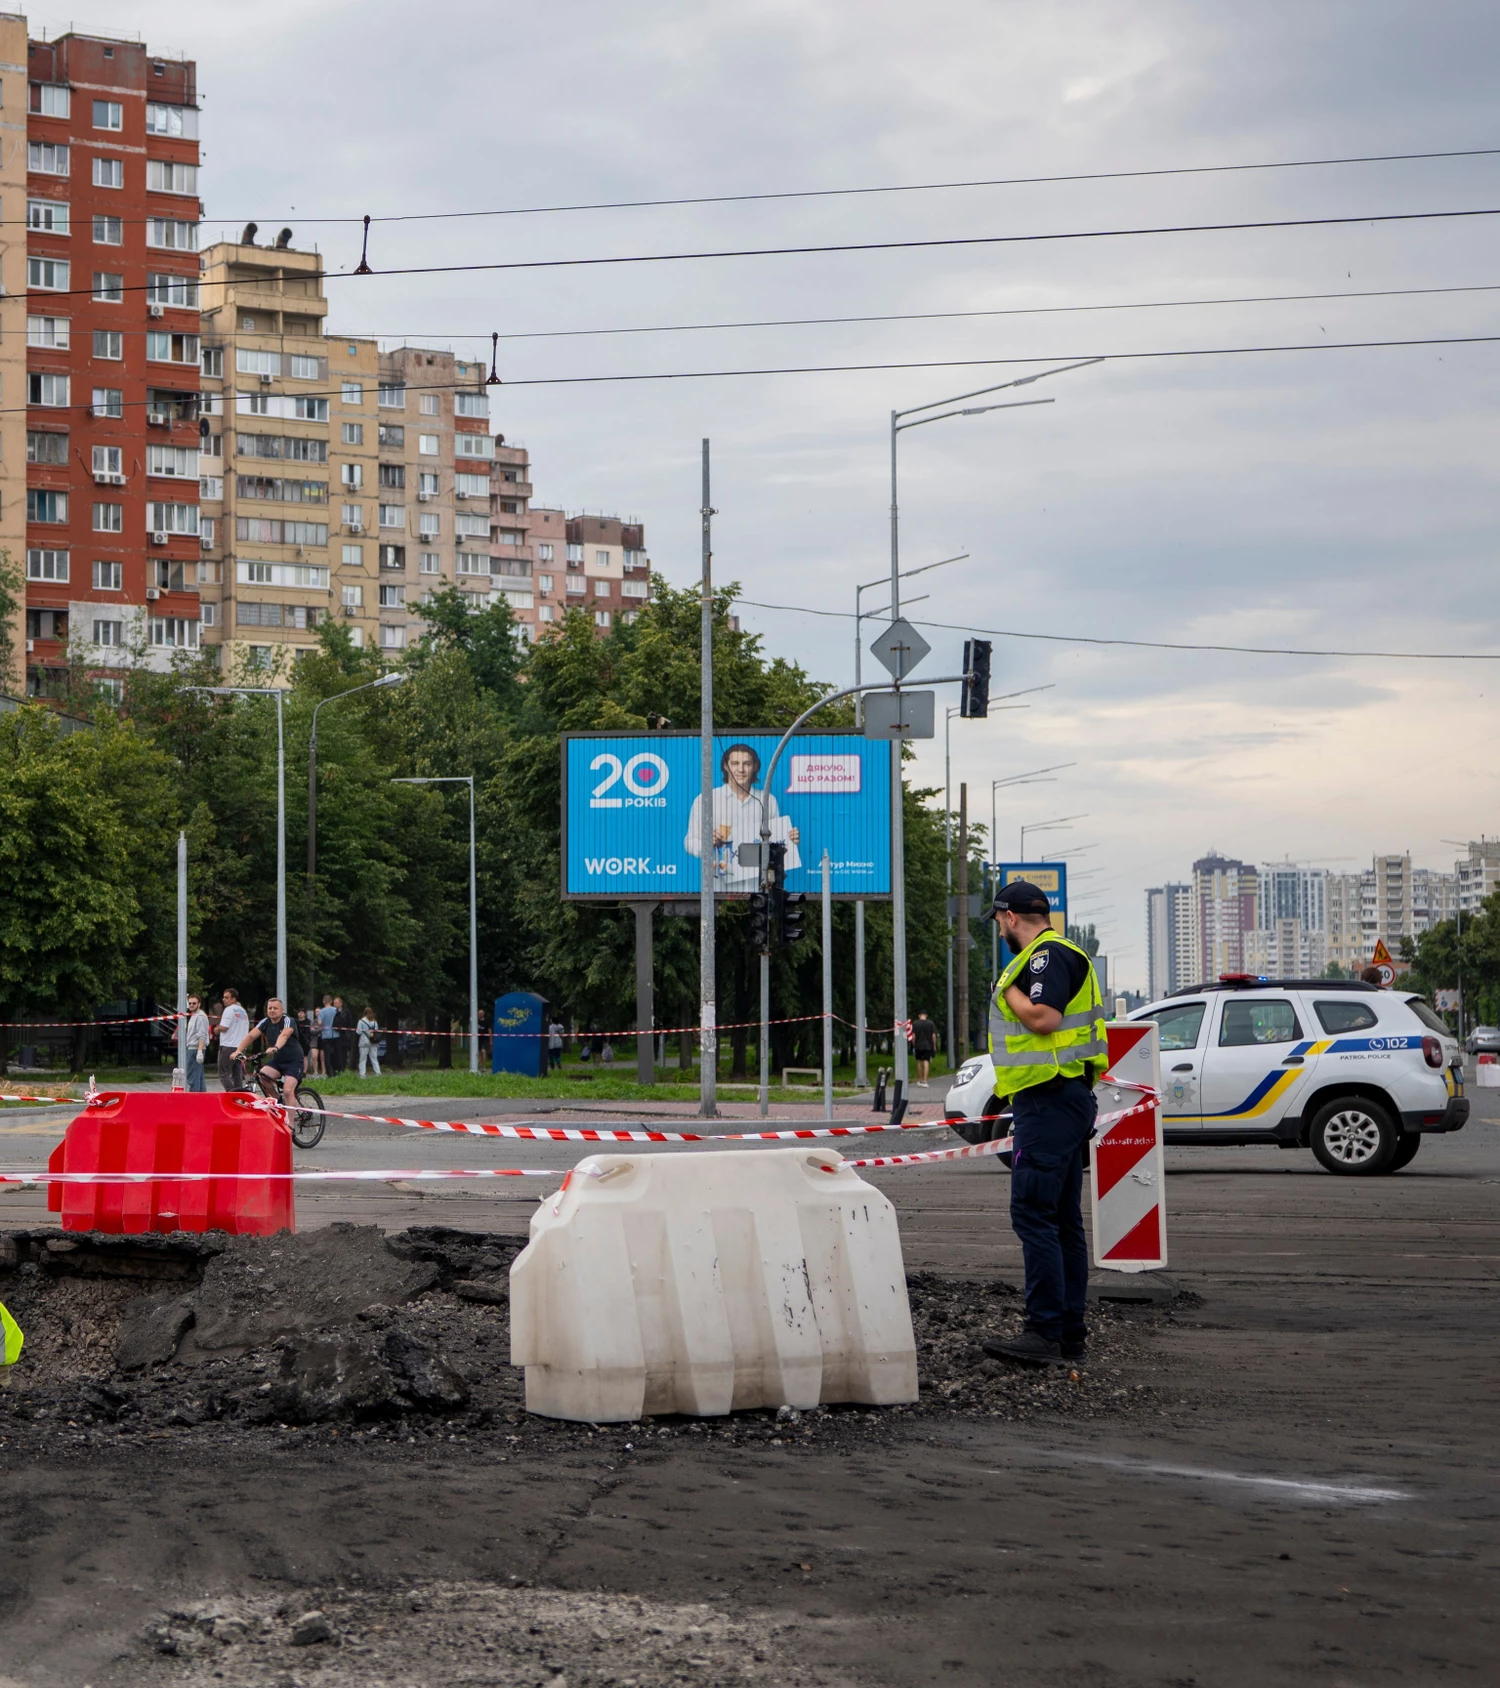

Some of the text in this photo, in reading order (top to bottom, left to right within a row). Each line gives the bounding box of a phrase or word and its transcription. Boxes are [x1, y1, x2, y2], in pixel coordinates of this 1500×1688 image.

[589, 752, 670, 808] 20
[797, 774, 856, 784] ЩО РАЗОМ!
[625, 797, 667, 808] РОКІВ
[584, 857, 677, 876] WORK.ua
[1385, 1037, 1408, 1049] 102
